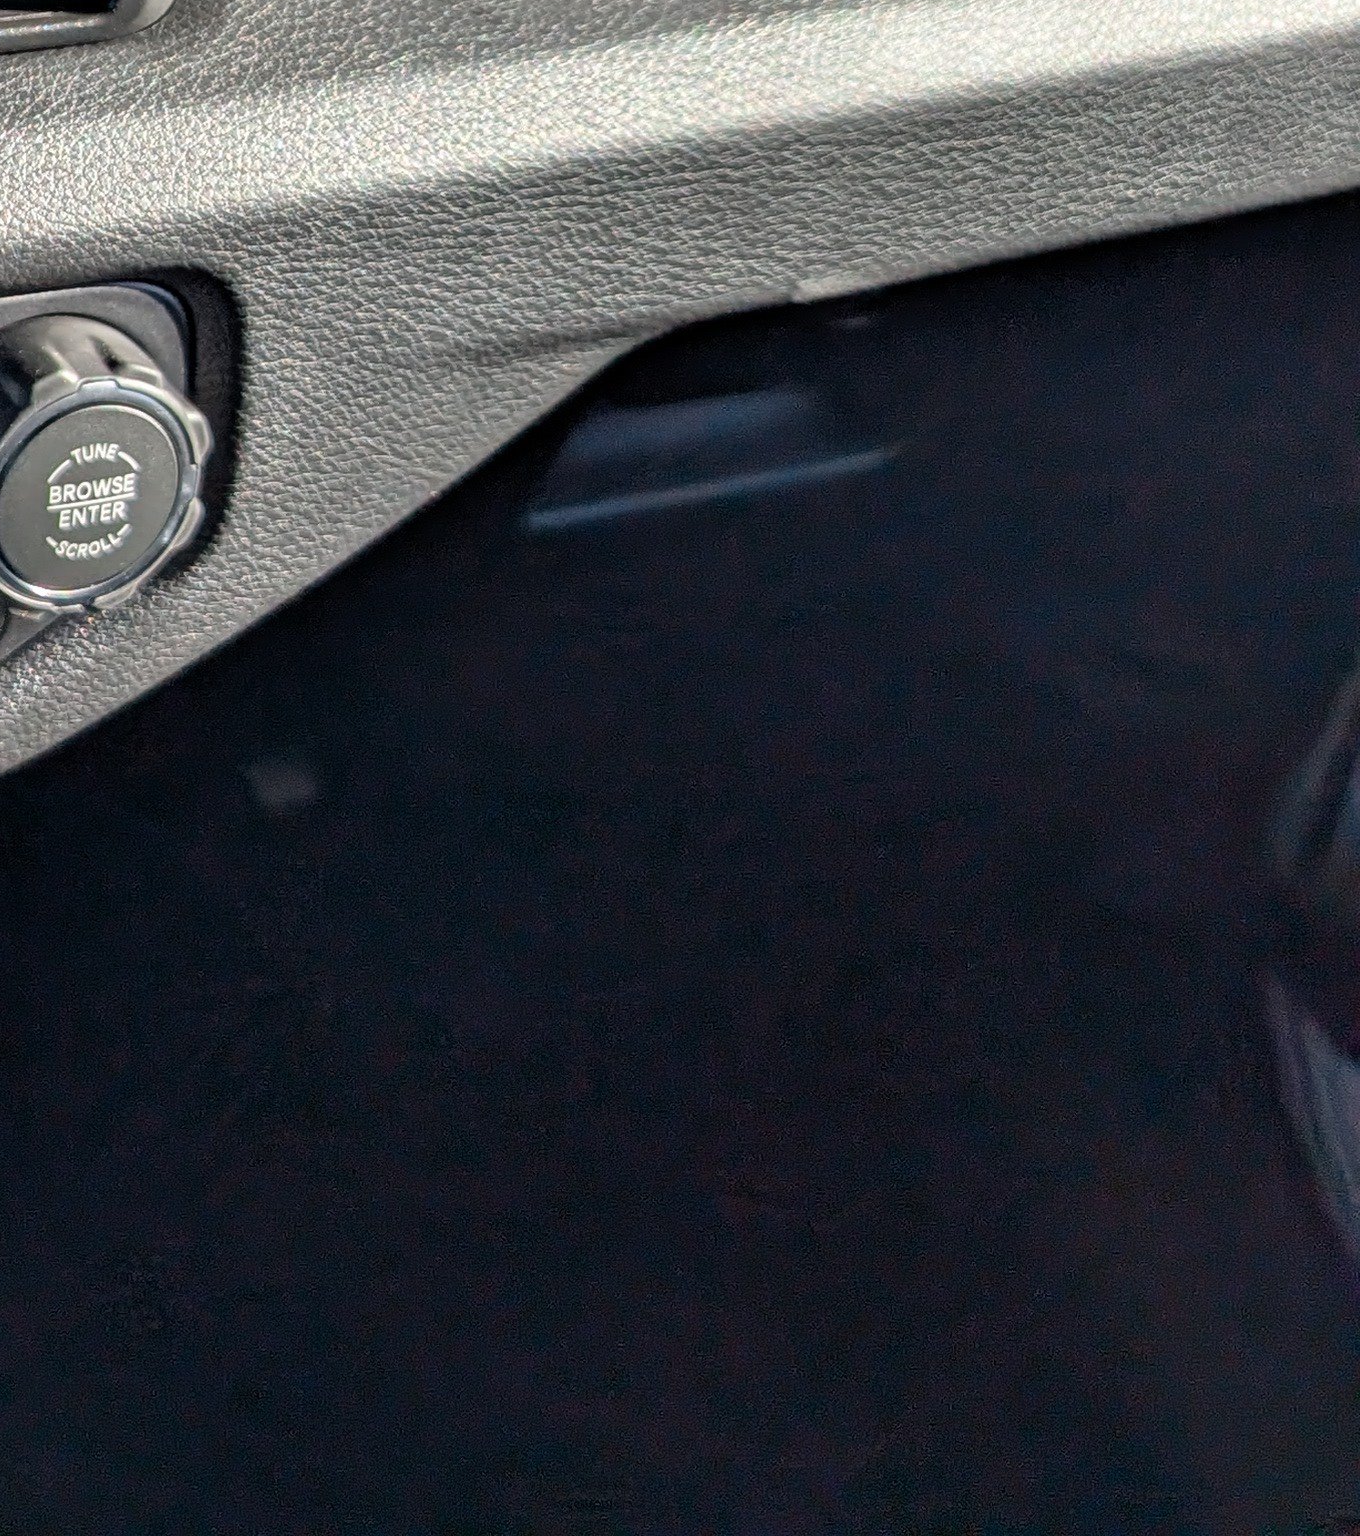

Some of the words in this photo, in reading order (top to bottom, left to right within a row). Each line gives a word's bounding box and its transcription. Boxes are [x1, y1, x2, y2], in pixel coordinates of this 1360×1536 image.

[70, 443, 121, 463] TUNE
[48, 473, 137, 504] BROWSE
[58, 502, 128, 530] ENTER
[55, 533, 122, 559] SCROLL
